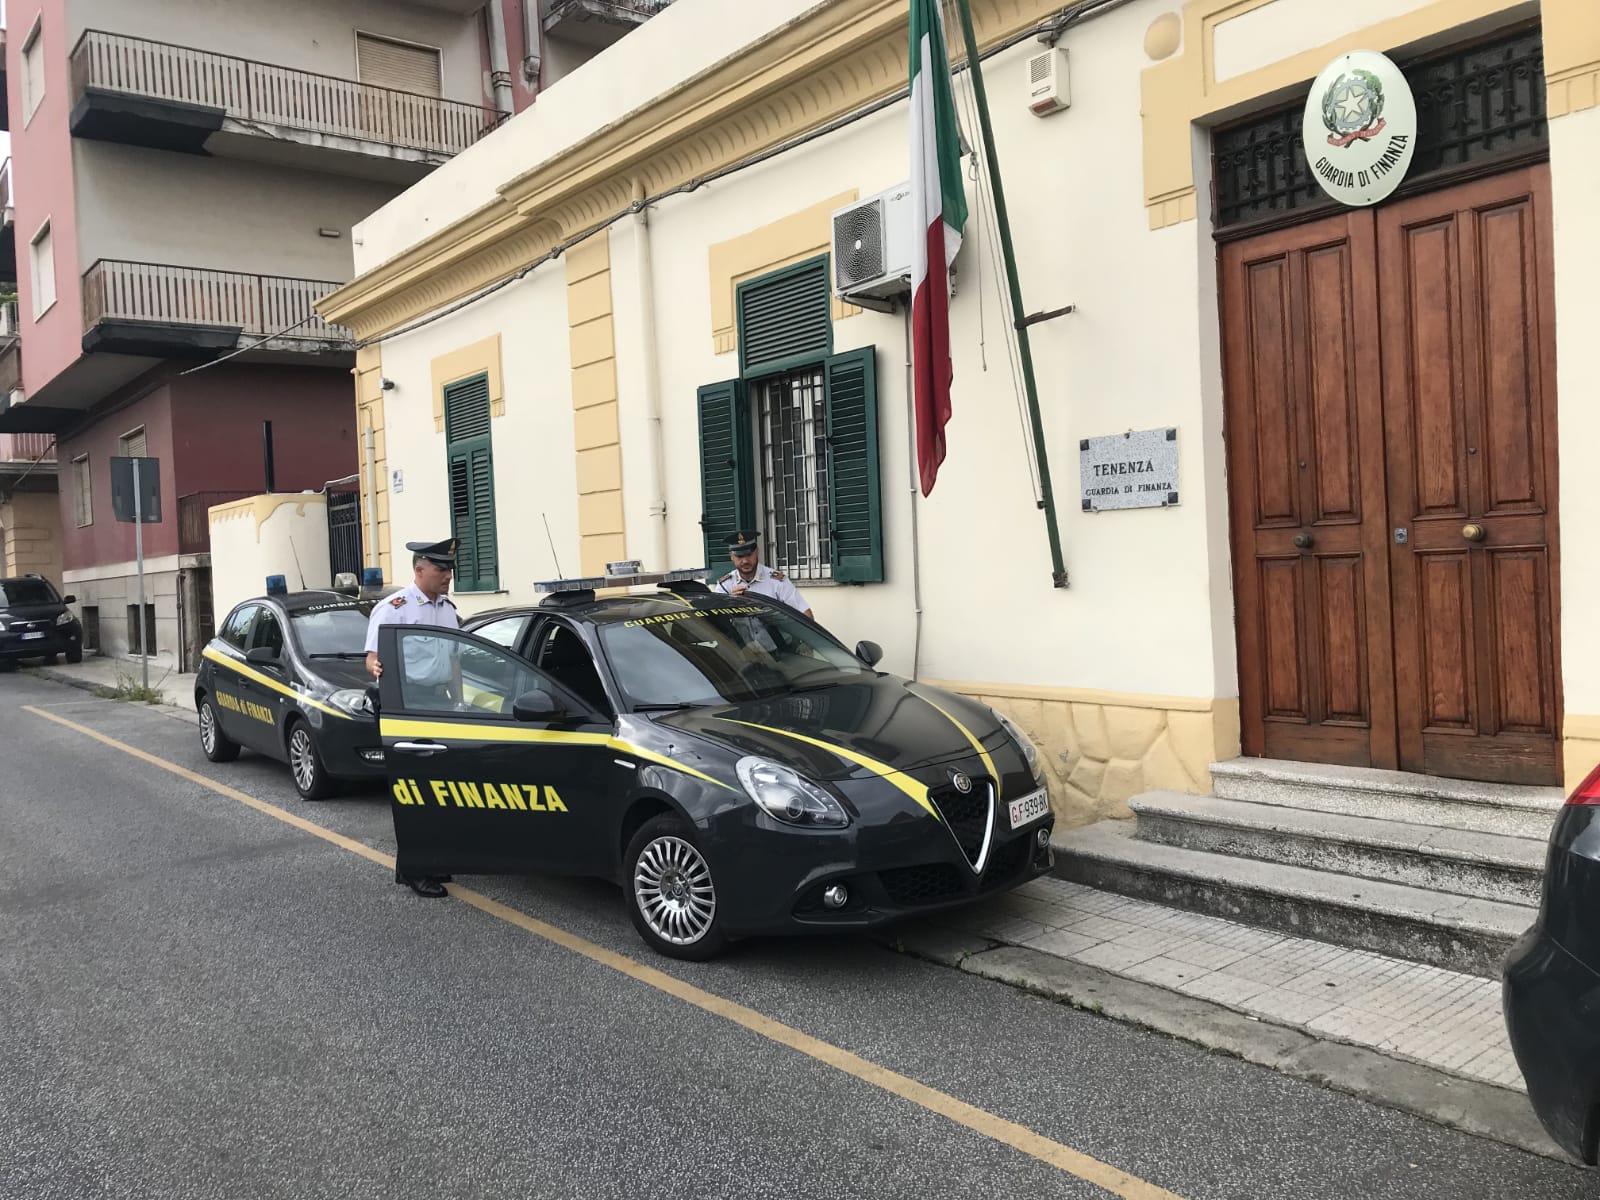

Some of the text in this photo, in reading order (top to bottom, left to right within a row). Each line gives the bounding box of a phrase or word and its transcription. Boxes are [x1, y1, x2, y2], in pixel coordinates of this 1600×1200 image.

[1315, 135, 1409, 188] GUARDIA DI FINANZA
[1093, 459, 1154, 477] TENENZA
[1085, 482, 1172, 497] GUARDIA DI FINANZA
[308, 601, 356, 611] GUARDIA
[623, 606, 763, 628] GUARDIA di FINANZA
[215, 690, 242, 713] GUARDIA
[246, 701, 276, 726] FINANZA
[392, 778, 569, 812] di FINANZA
